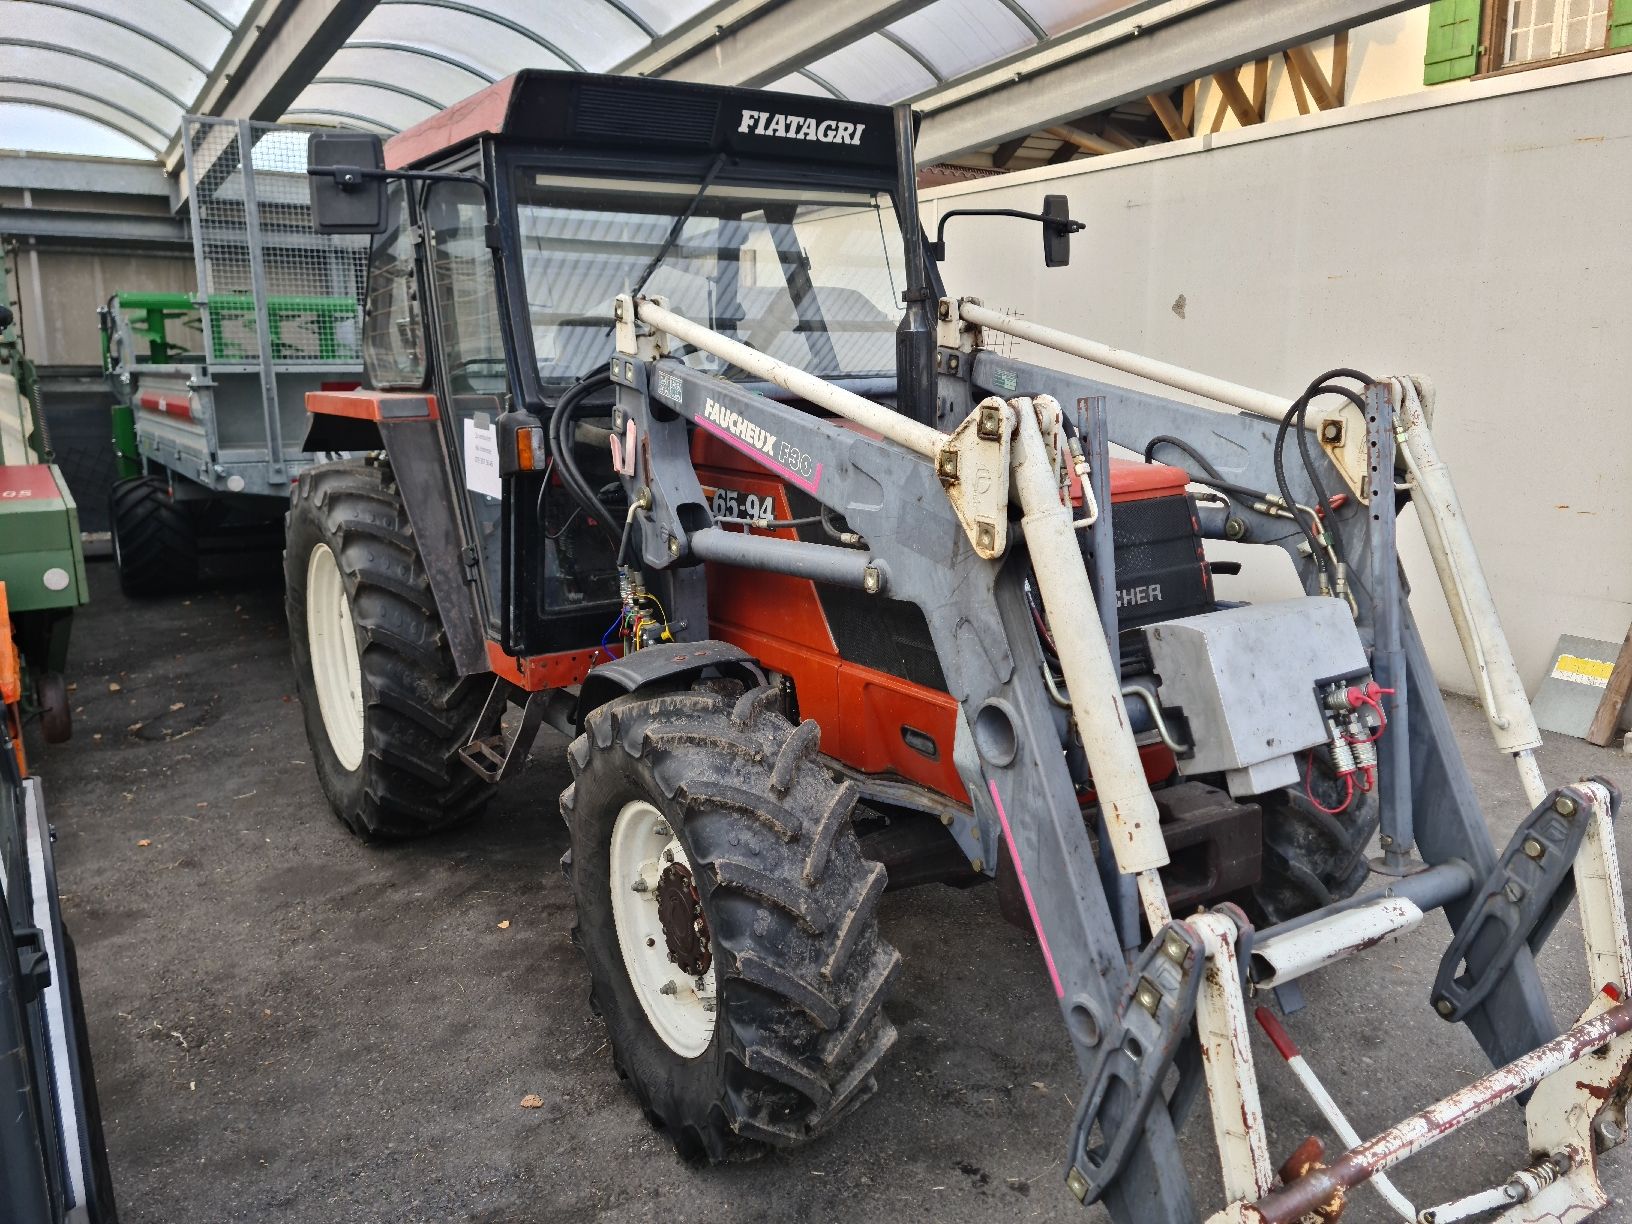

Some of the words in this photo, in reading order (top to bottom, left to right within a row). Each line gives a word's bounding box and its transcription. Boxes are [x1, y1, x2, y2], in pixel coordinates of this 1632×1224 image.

[738, 110, 866, 145] FIATAGRI
[704, 397, 777, 456] FAUCHEUX
[712, 488, 774, 521] 65-94
